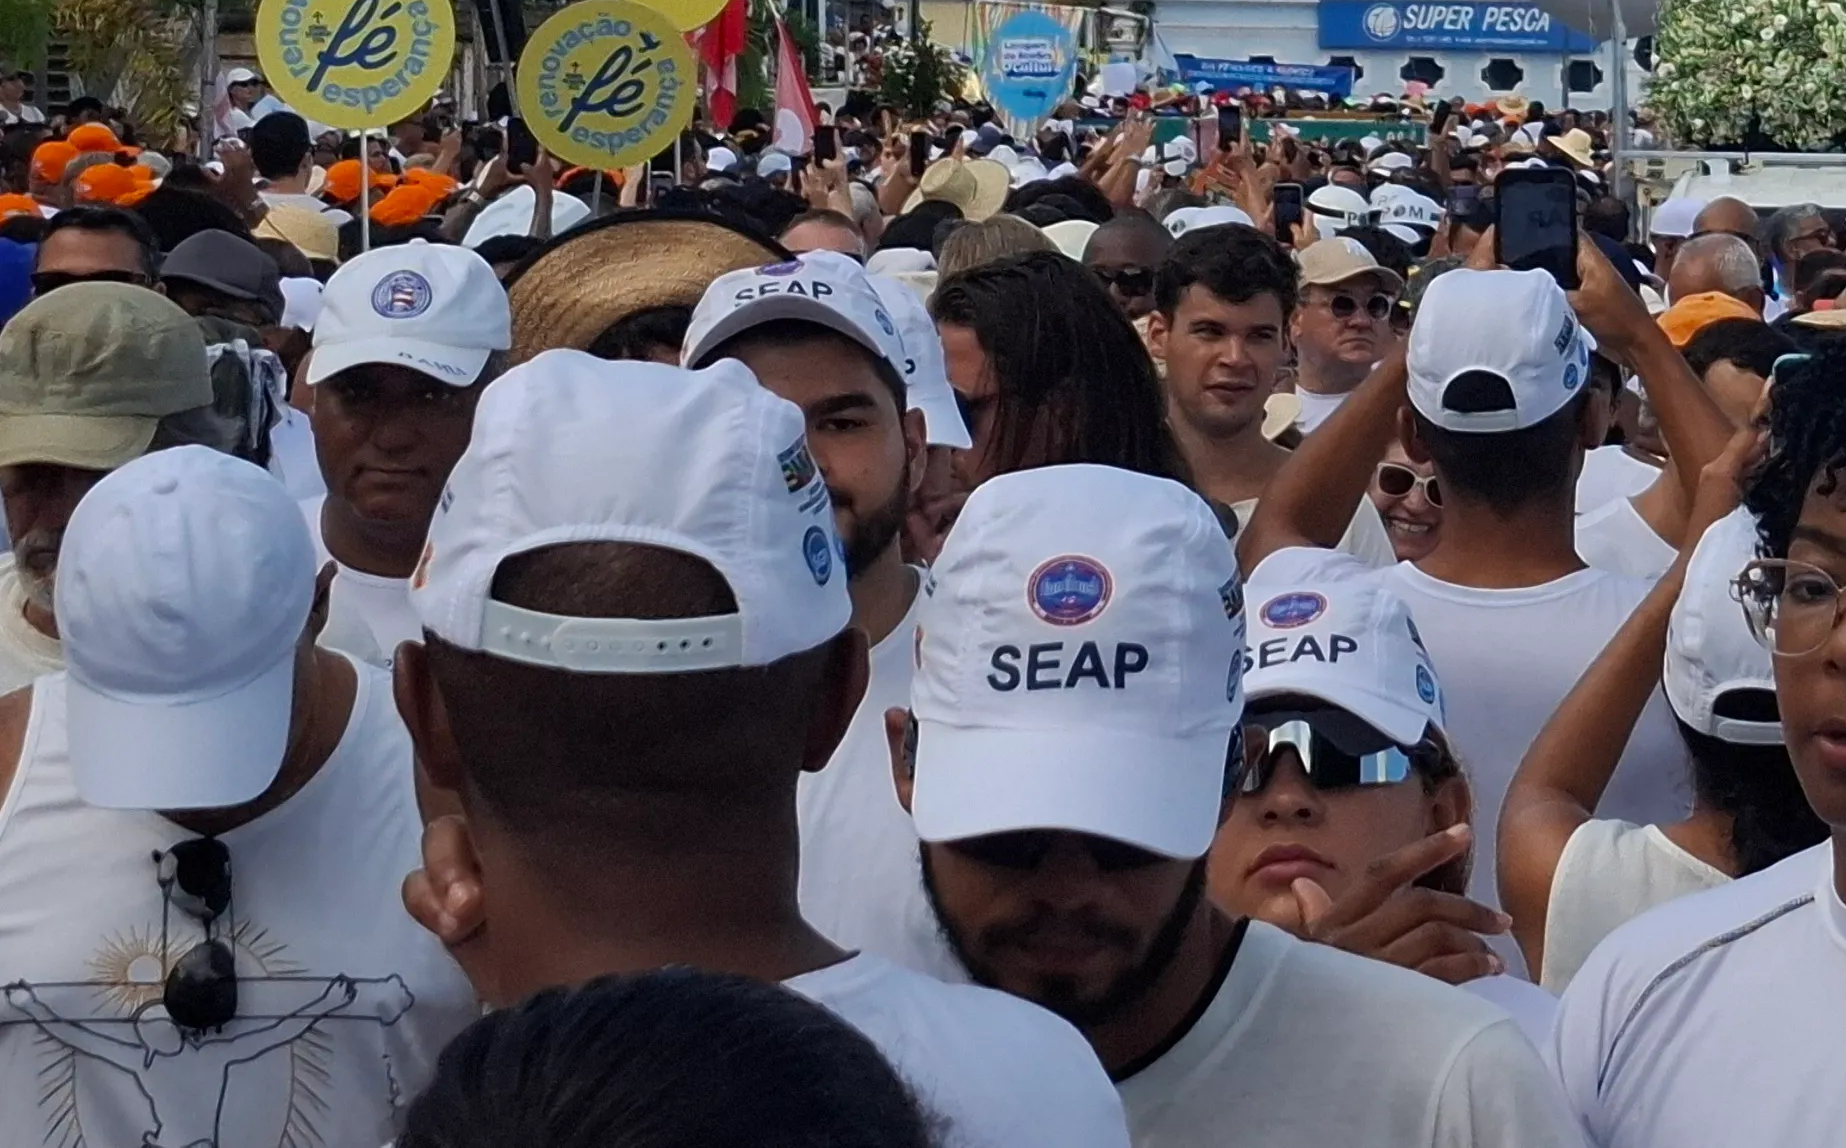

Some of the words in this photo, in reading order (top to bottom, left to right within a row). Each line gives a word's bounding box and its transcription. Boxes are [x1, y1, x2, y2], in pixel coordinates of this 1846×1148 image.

[1402, 4, 1474, 31] SUPER
[1482, 6, 1551, 33] PESCA
[538, 12, 633, 118] renovação
[985, 640, 1150, 692] SEAP
